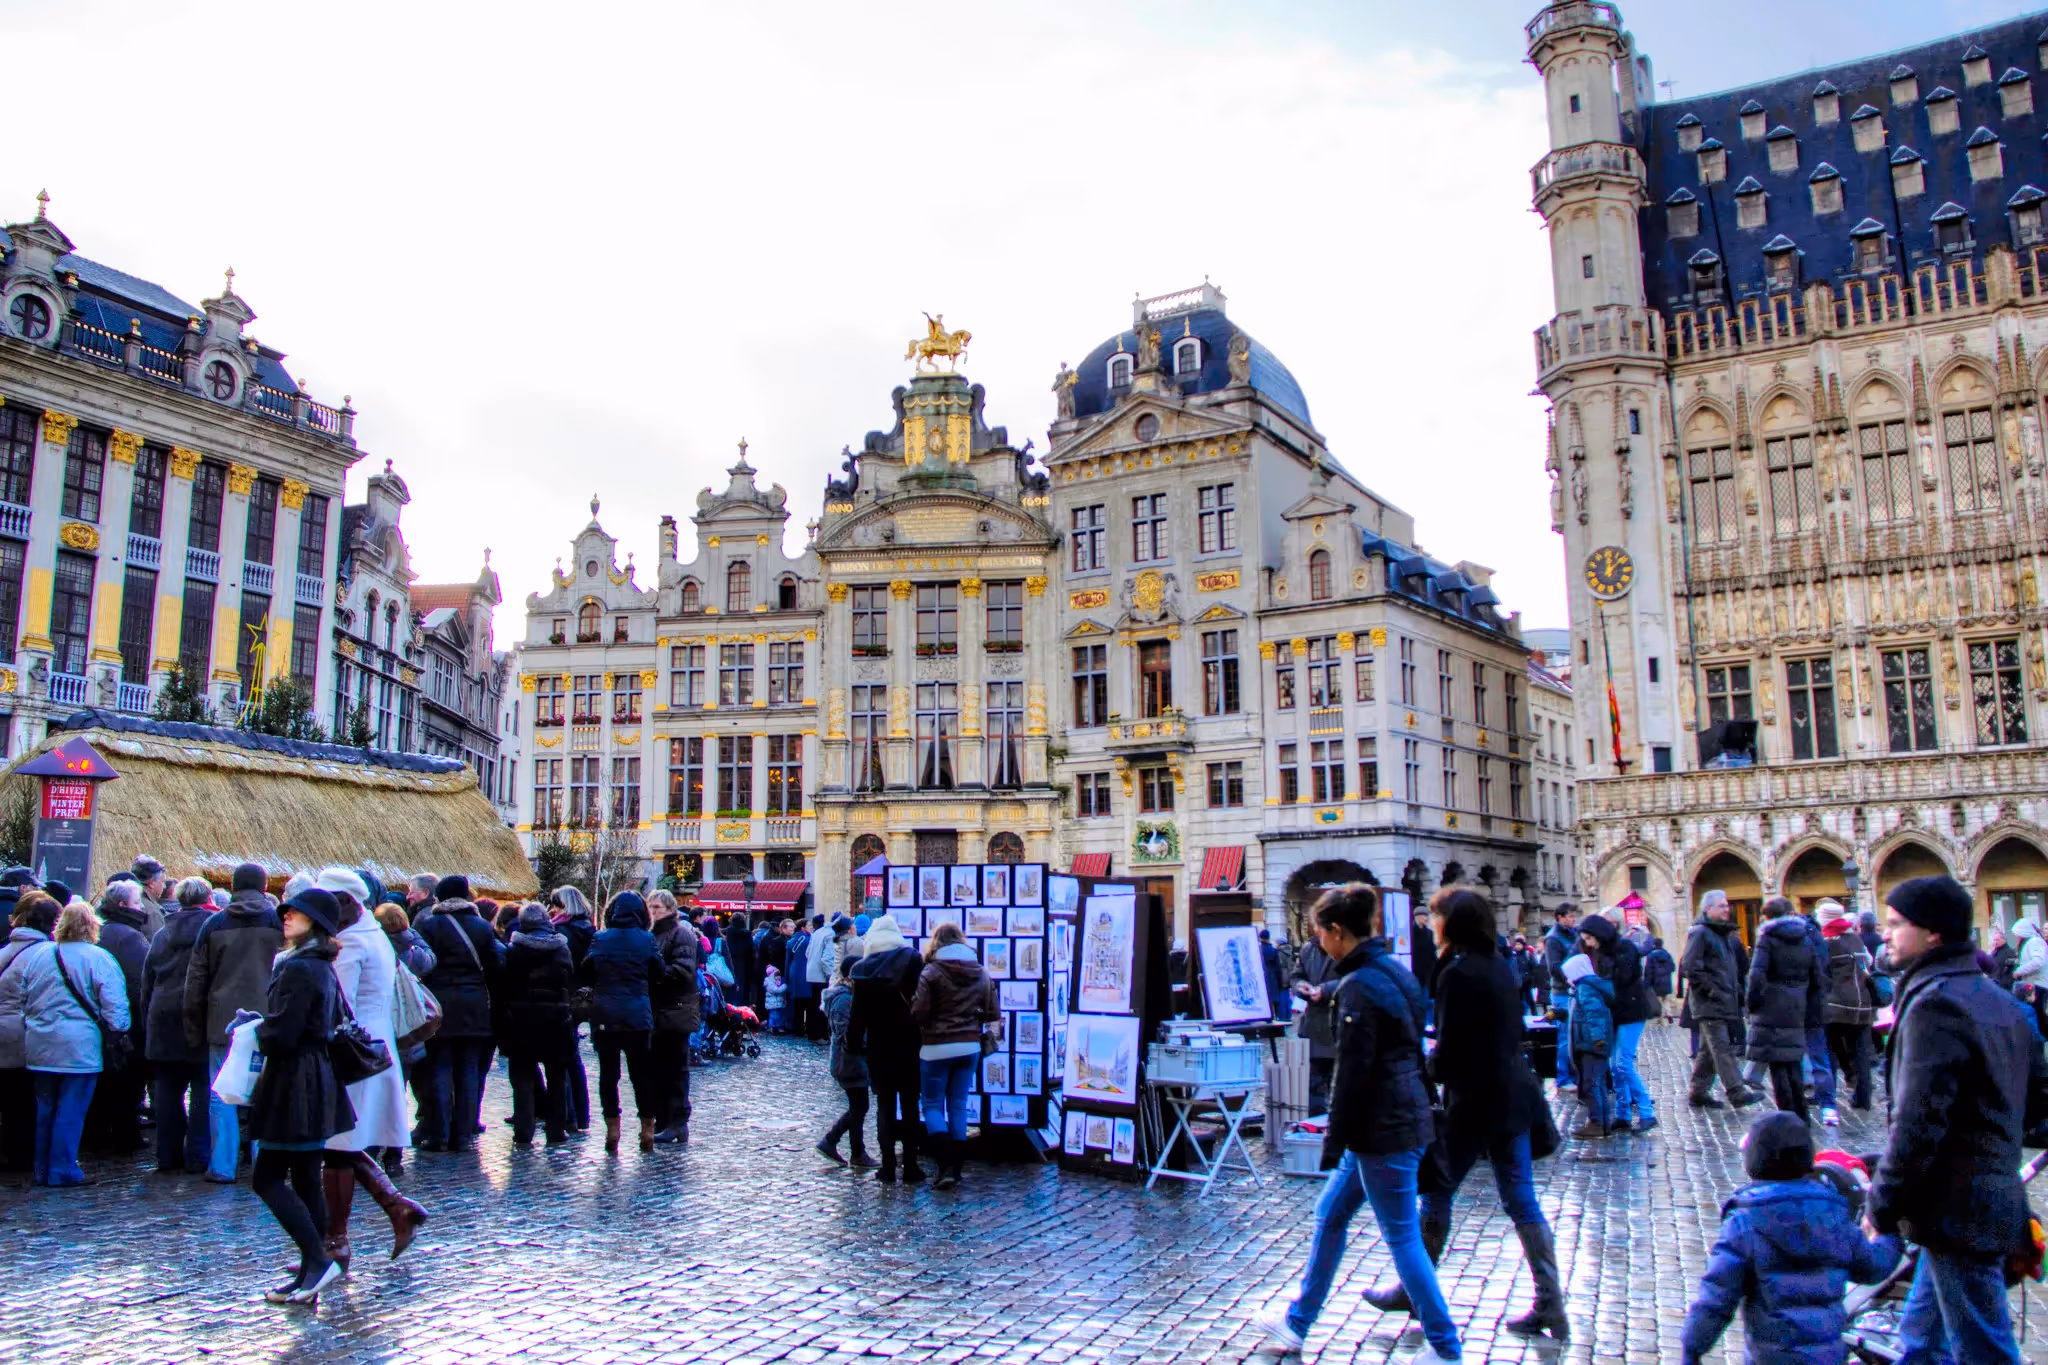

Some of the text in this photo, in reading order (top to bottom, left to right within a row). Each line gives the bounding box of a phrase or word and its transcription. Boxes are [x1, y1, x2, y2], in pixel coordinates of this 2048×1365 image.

[1021, 496, 1049, 506] 1698
[826, 503, 853, 513] ANNO
[51, 785, 87, 795] D'HIVER
[51, 799, 85, 808] WINTER
[55, 808, 79, 817] PRET
